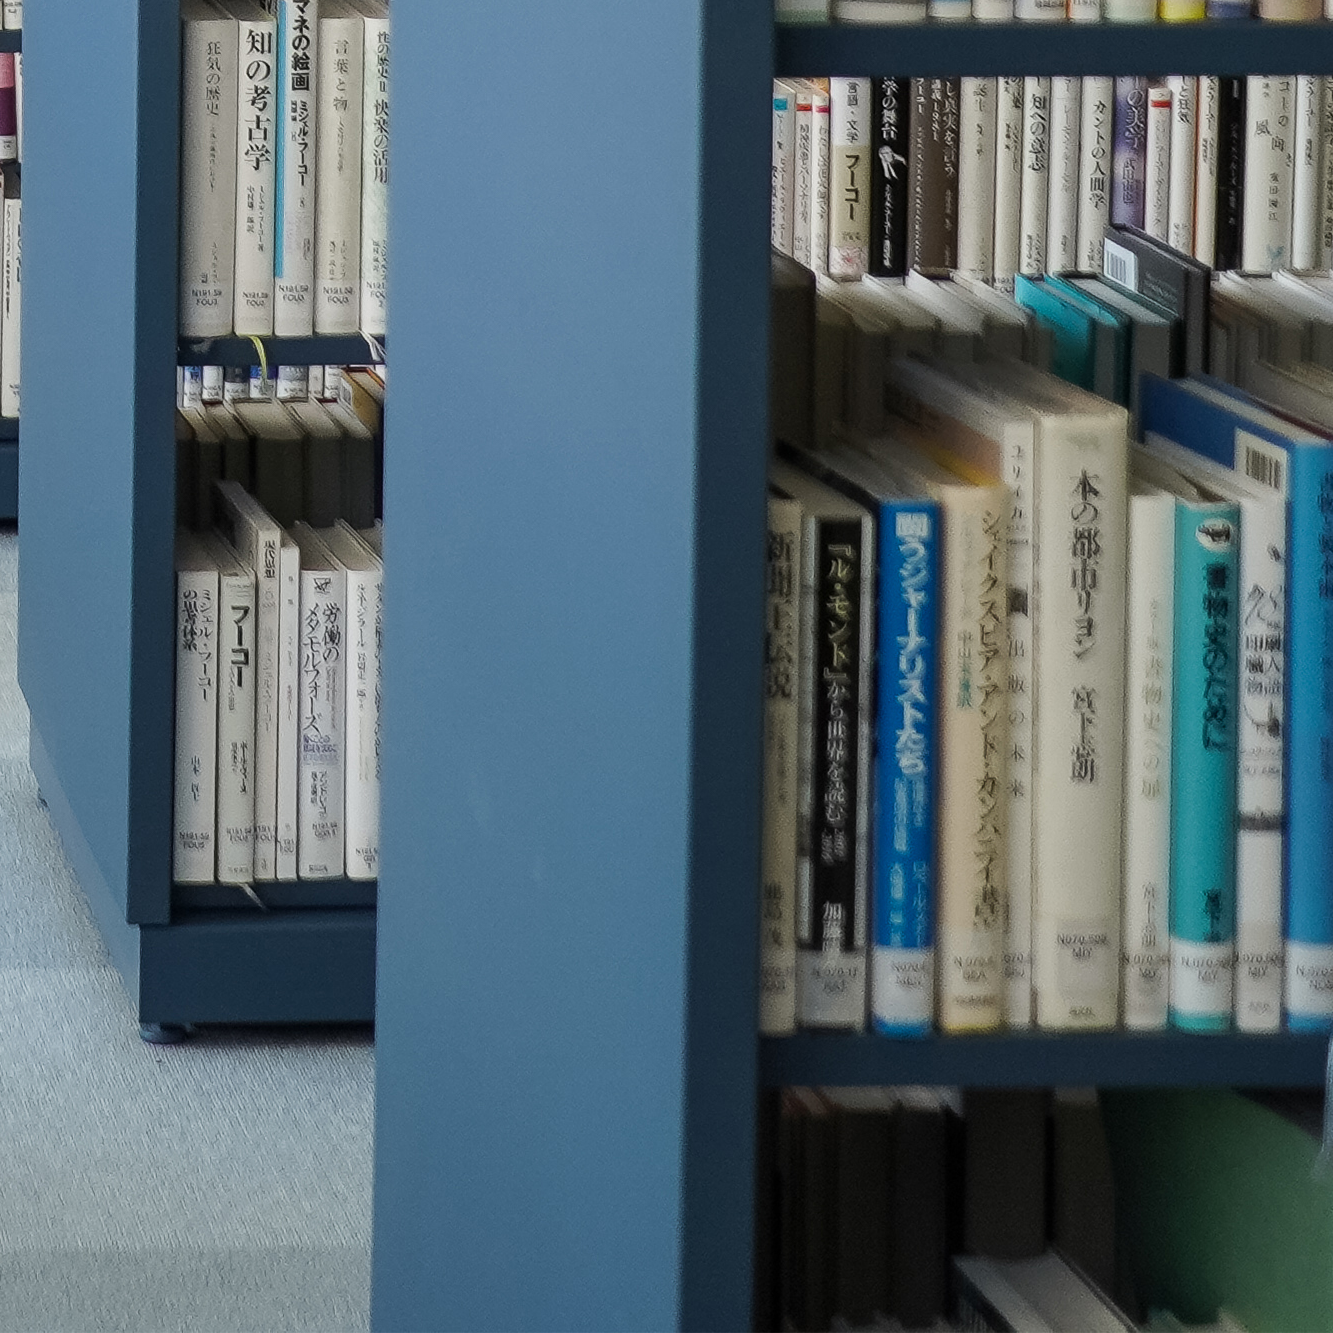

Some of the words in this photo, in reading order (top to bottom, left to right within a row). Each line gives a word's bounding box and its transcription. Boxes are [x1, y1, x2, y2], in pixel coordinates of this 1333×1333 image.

[206, 40, 221, 117] 狂気の歴史
[245, 28, 272, 172] 知の考古学
[333, 38, 348, 112] 言葉と物
[844, 154, 860, 221] フーコー
[1090, 99, 1106, 210] カントの人間学
[1070, 468, 1102, 661] 本の都市リヨン
[198, 590, 214, 702] ミシェル・フーコー
[230, 604, 250, 688] フーコー
[303, 602, 323, 738] メタモルフォーズ
[323, 601, 341, 663] 労働の
